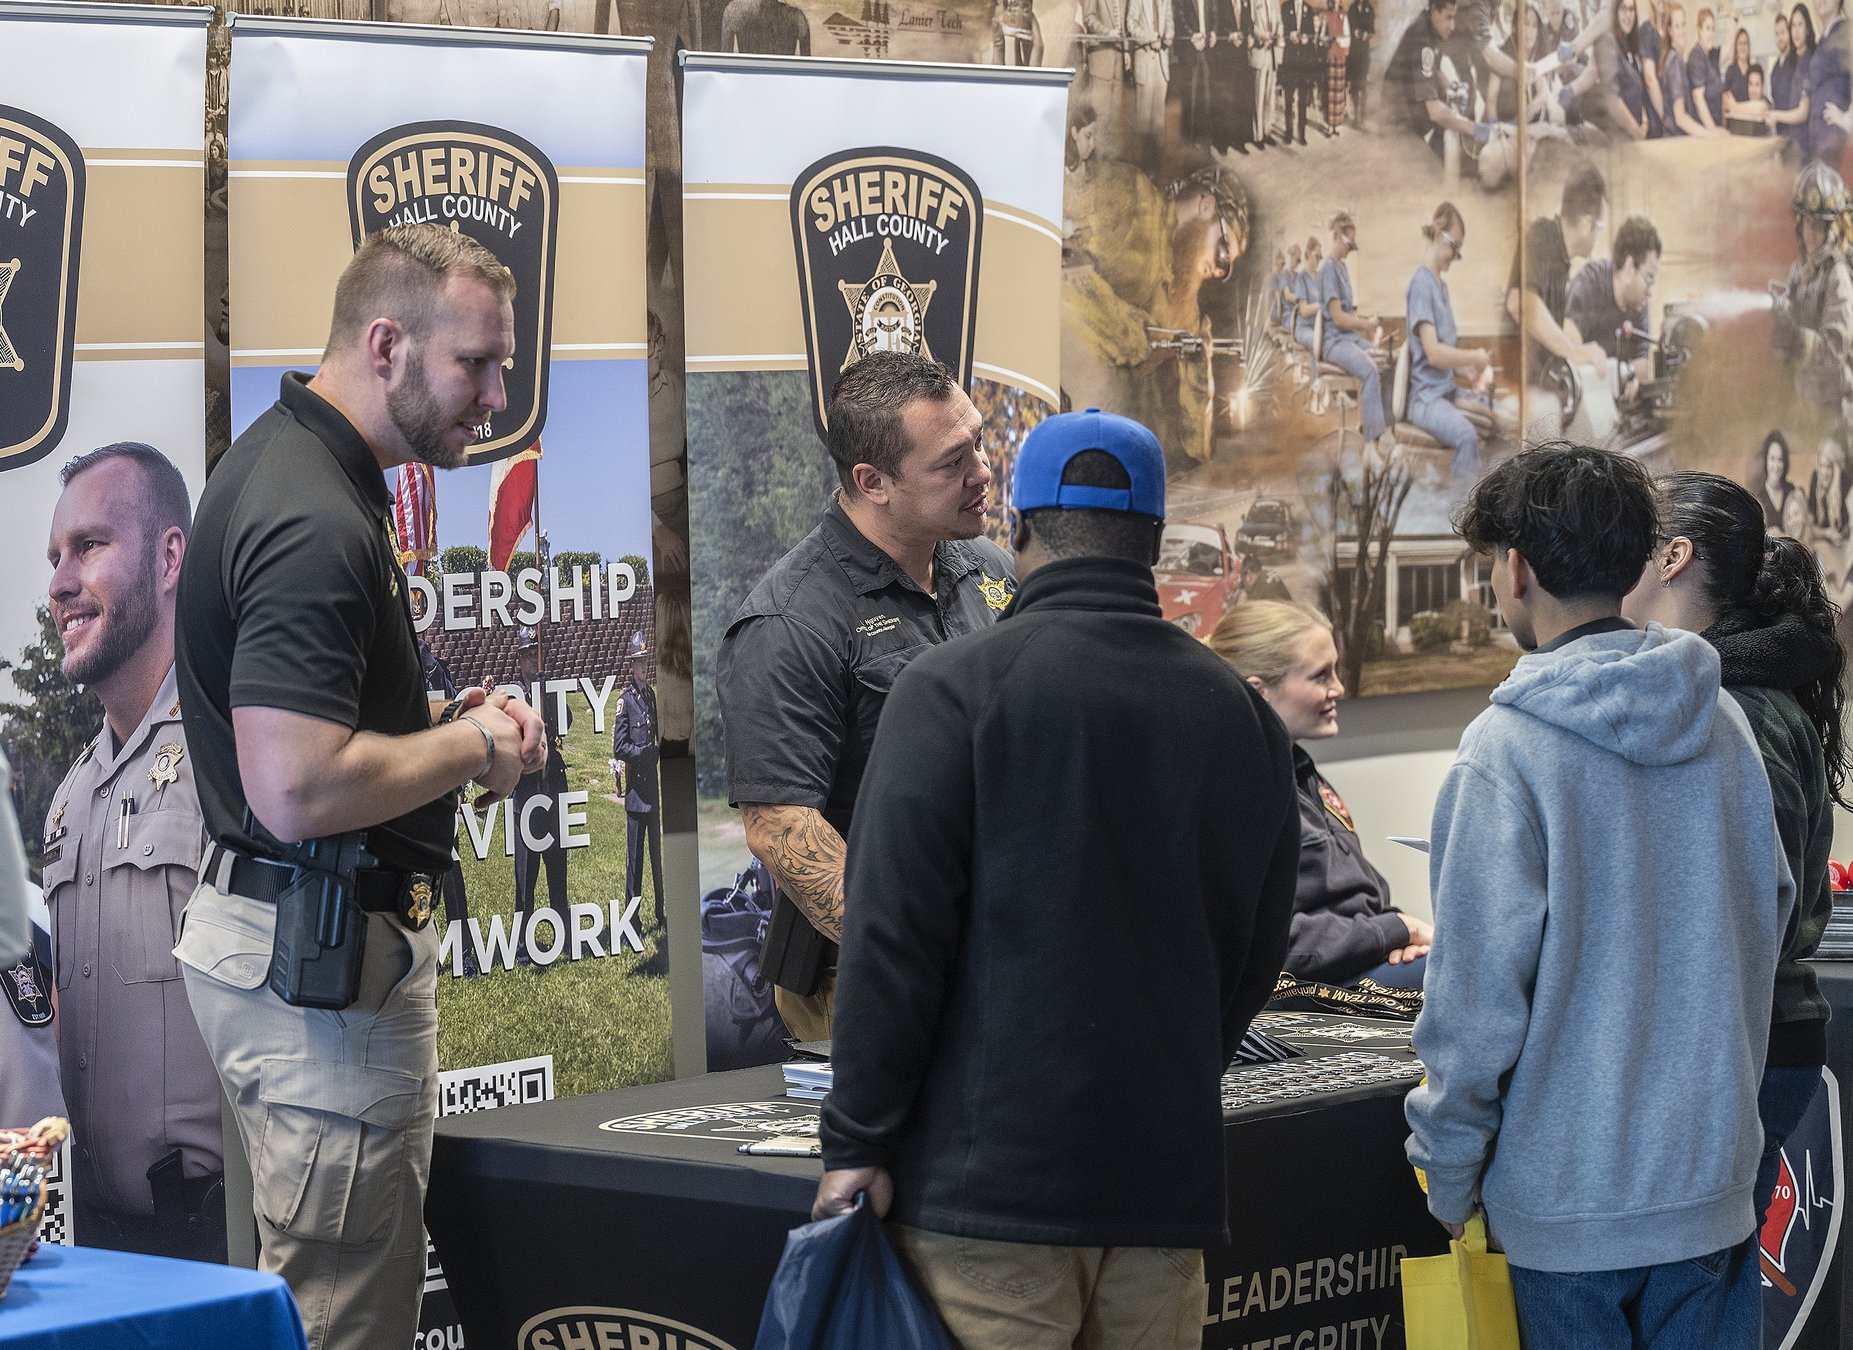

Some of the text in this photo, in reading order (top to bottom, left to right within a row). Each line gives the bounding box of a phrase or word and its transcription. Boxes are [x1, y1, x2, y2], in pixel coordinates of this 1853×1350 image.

[899, 8, 963, 30] Lanier Tech
[368, 147, 536, 214] SHERIFF
[810, 170, 964, 233] SHERIFF
[442, 194, 523, 239] COUNTY
[828, 214, 950, 257] HALL COUNTY
[855, 276, 922, 342] STATE OF GEORGIA
[873, 292, 906, 312] CONSTITUTION
[1331, 989, 1366, 1004] TEAM
